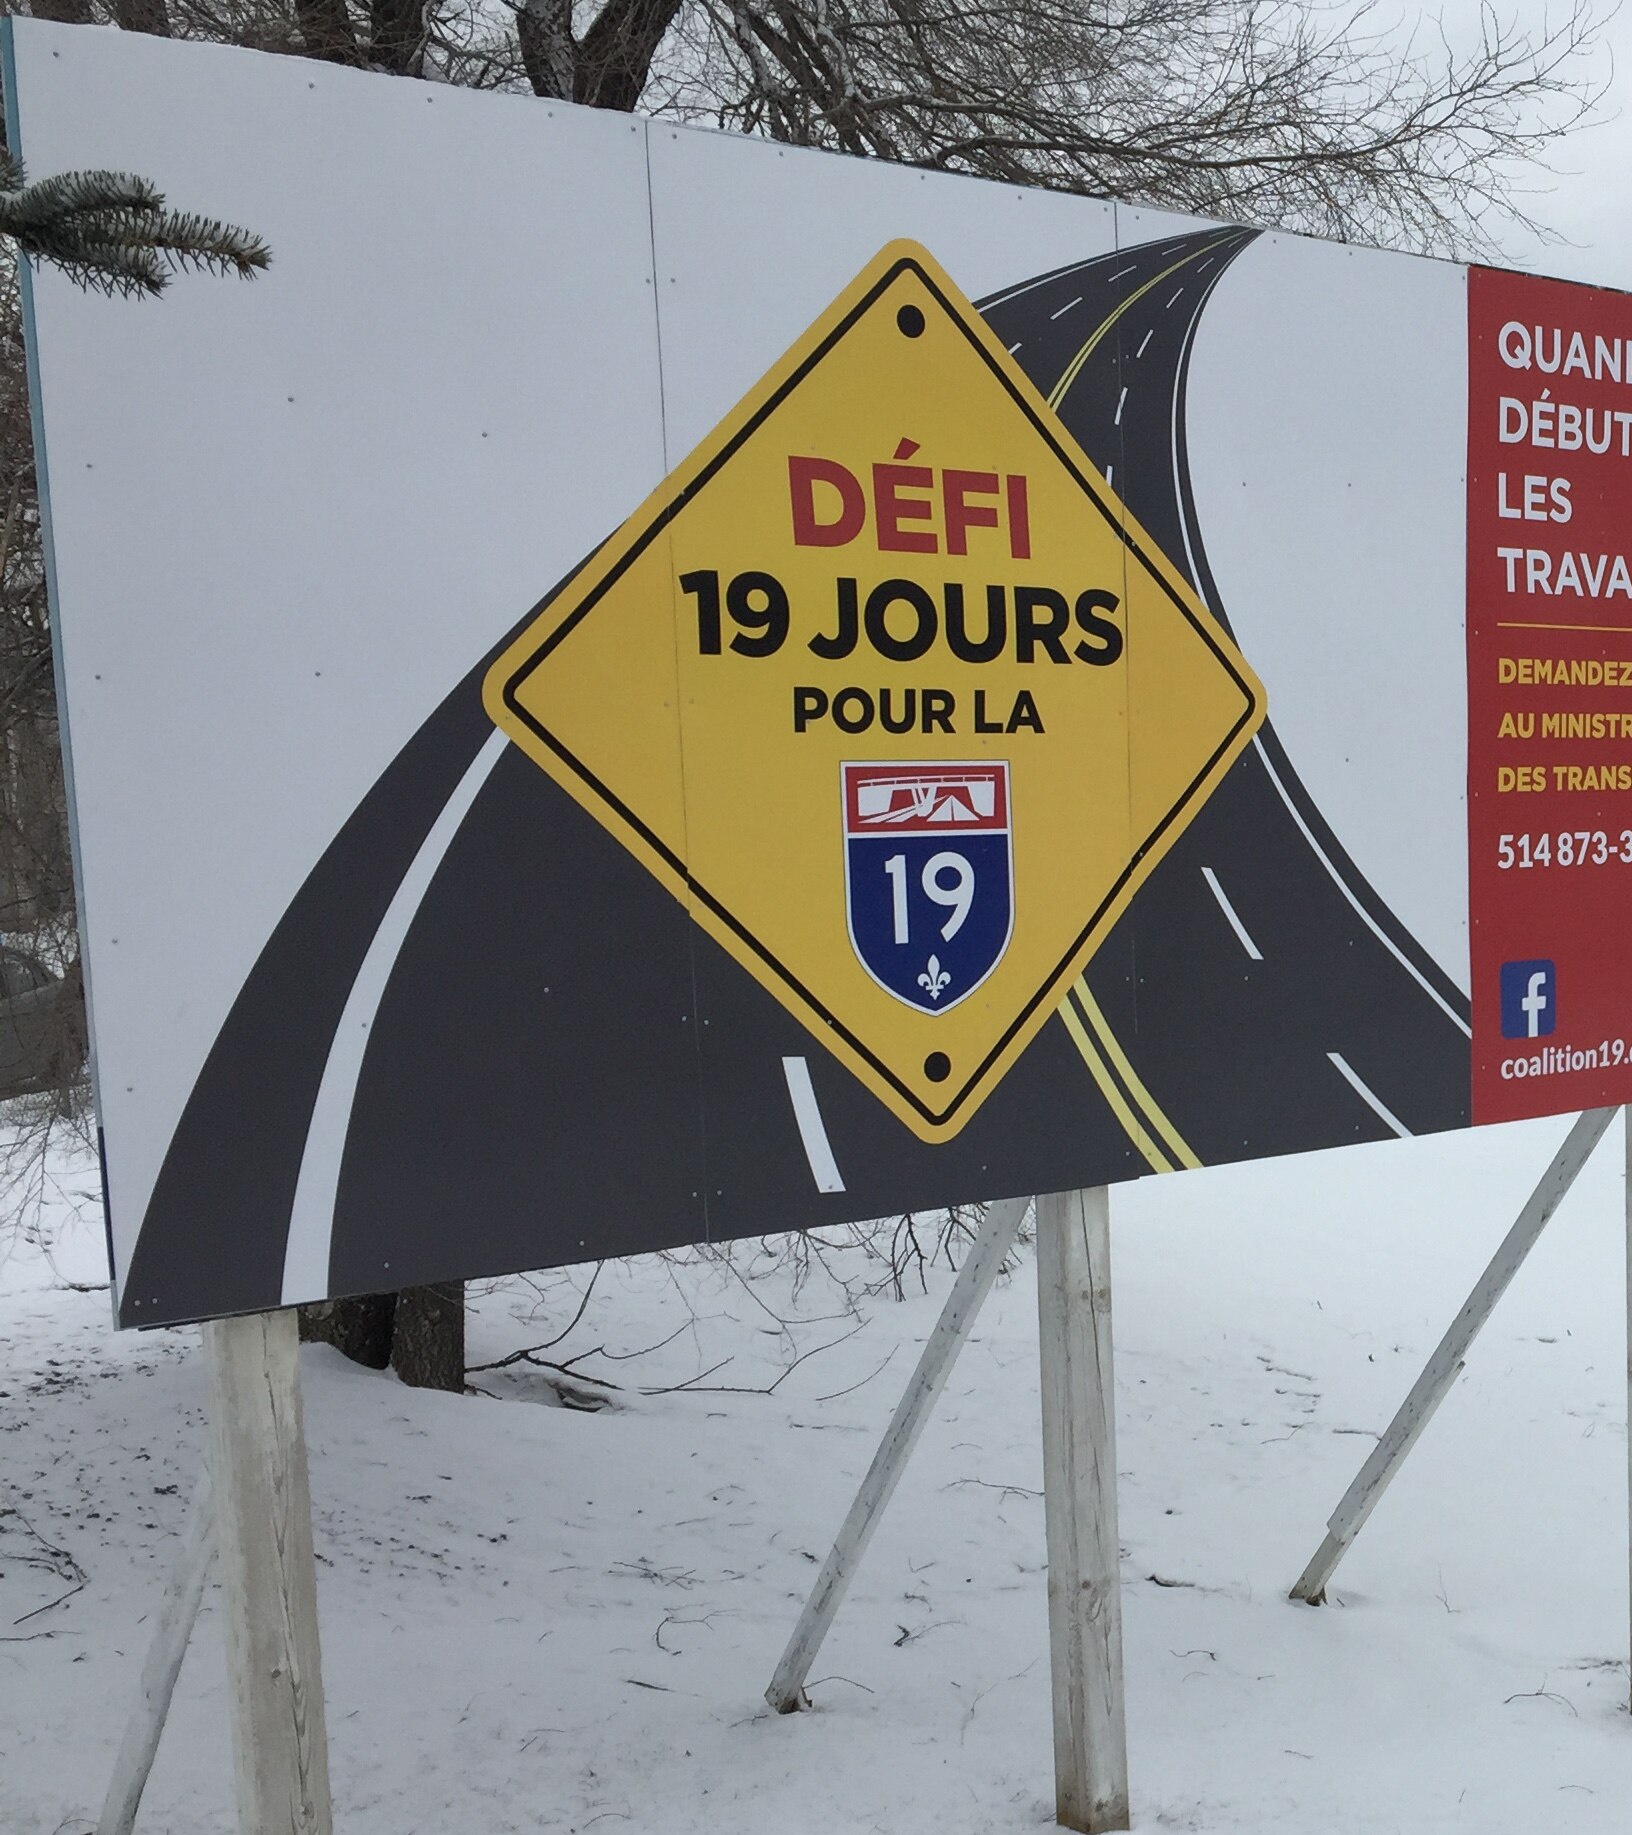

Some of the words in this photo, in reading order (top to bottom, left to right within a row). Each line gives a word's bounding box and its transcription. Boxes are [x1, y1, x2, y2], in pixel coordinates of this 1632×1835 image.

[788, 437, 1031, 560] DÉFI
[1498, 472, 1573, 523] LES
[679, 569, 790, 658] 19
[807, 577, 1124, 666] JOURS
[793, 687, 956, 734] POUR
[974, 690, 1045, 734] LA
[1498, 713, 1535, 739] AU
[1498, 766, 1546, 792] DES
[1498, 833, 1551, 869] 514
[885, 852, 975, 944] 19
